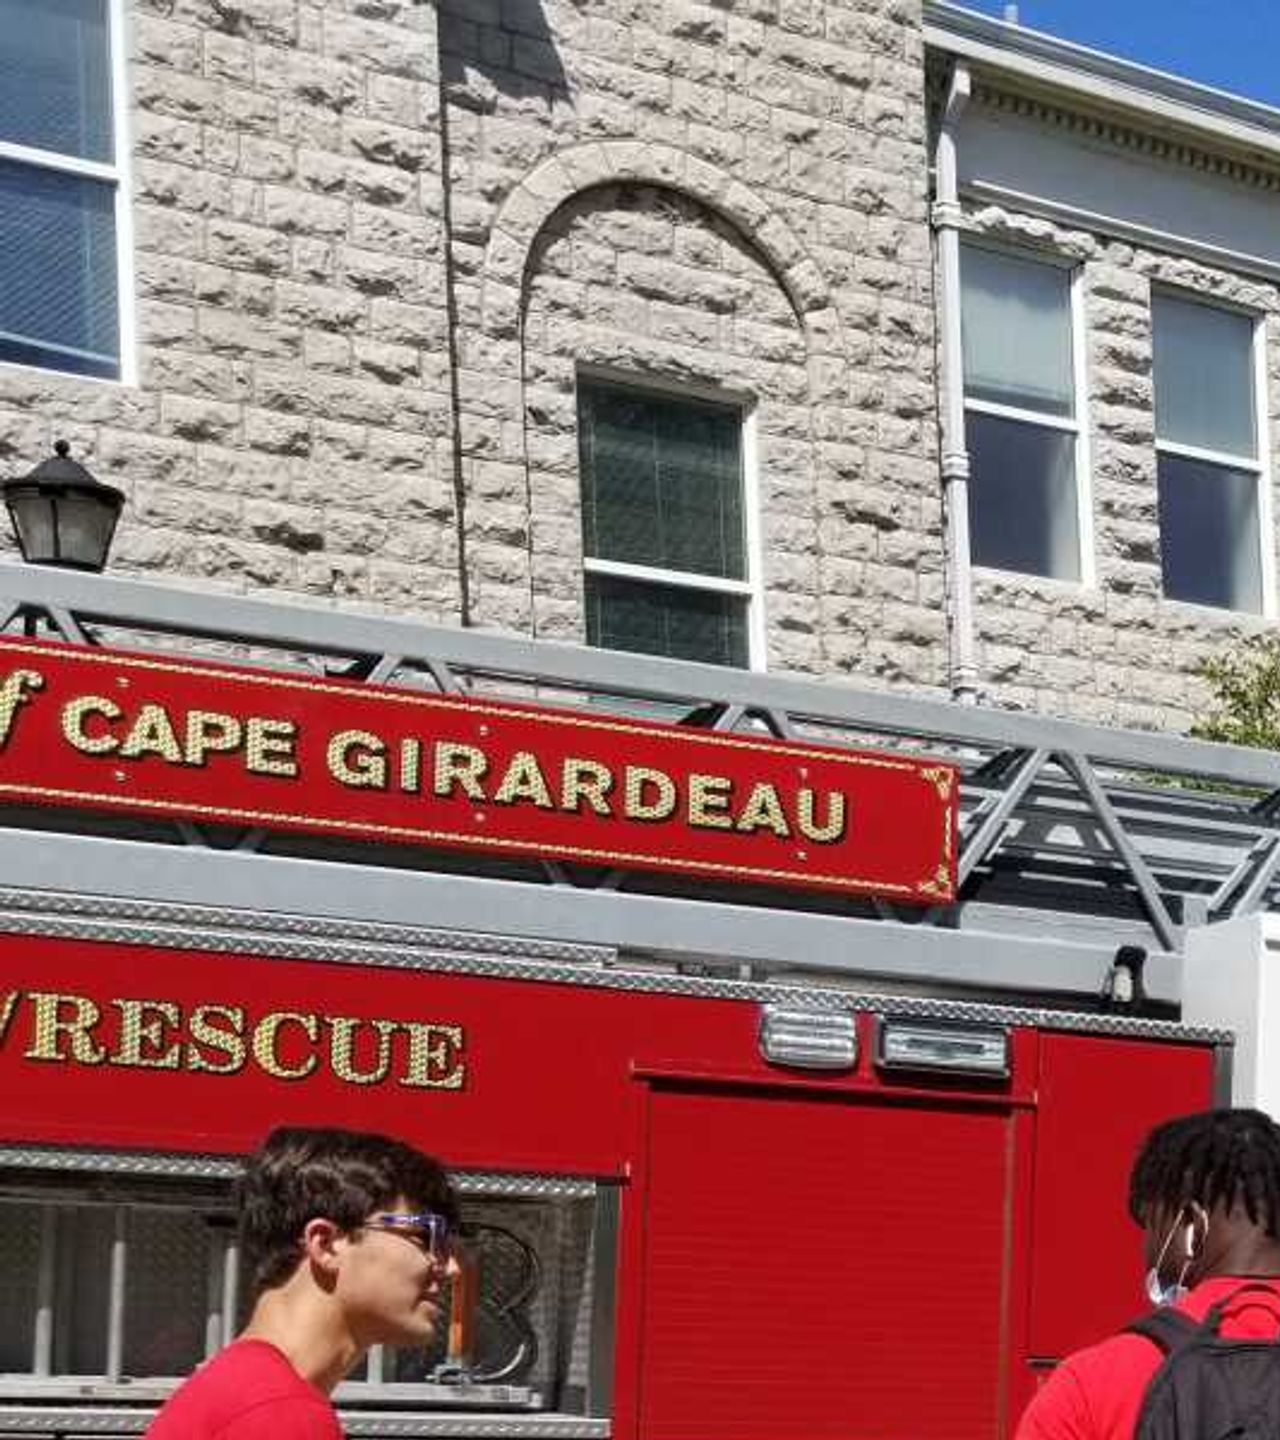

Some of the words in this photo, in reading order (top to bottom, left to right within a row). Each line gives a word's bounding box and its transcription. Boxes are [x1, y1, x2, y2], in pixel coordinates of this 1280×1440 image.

[0, 669, 43, 749] f
[61, 695, 298, 777] CAPE
[327, 728, 845, 843] GIRARDEAU
